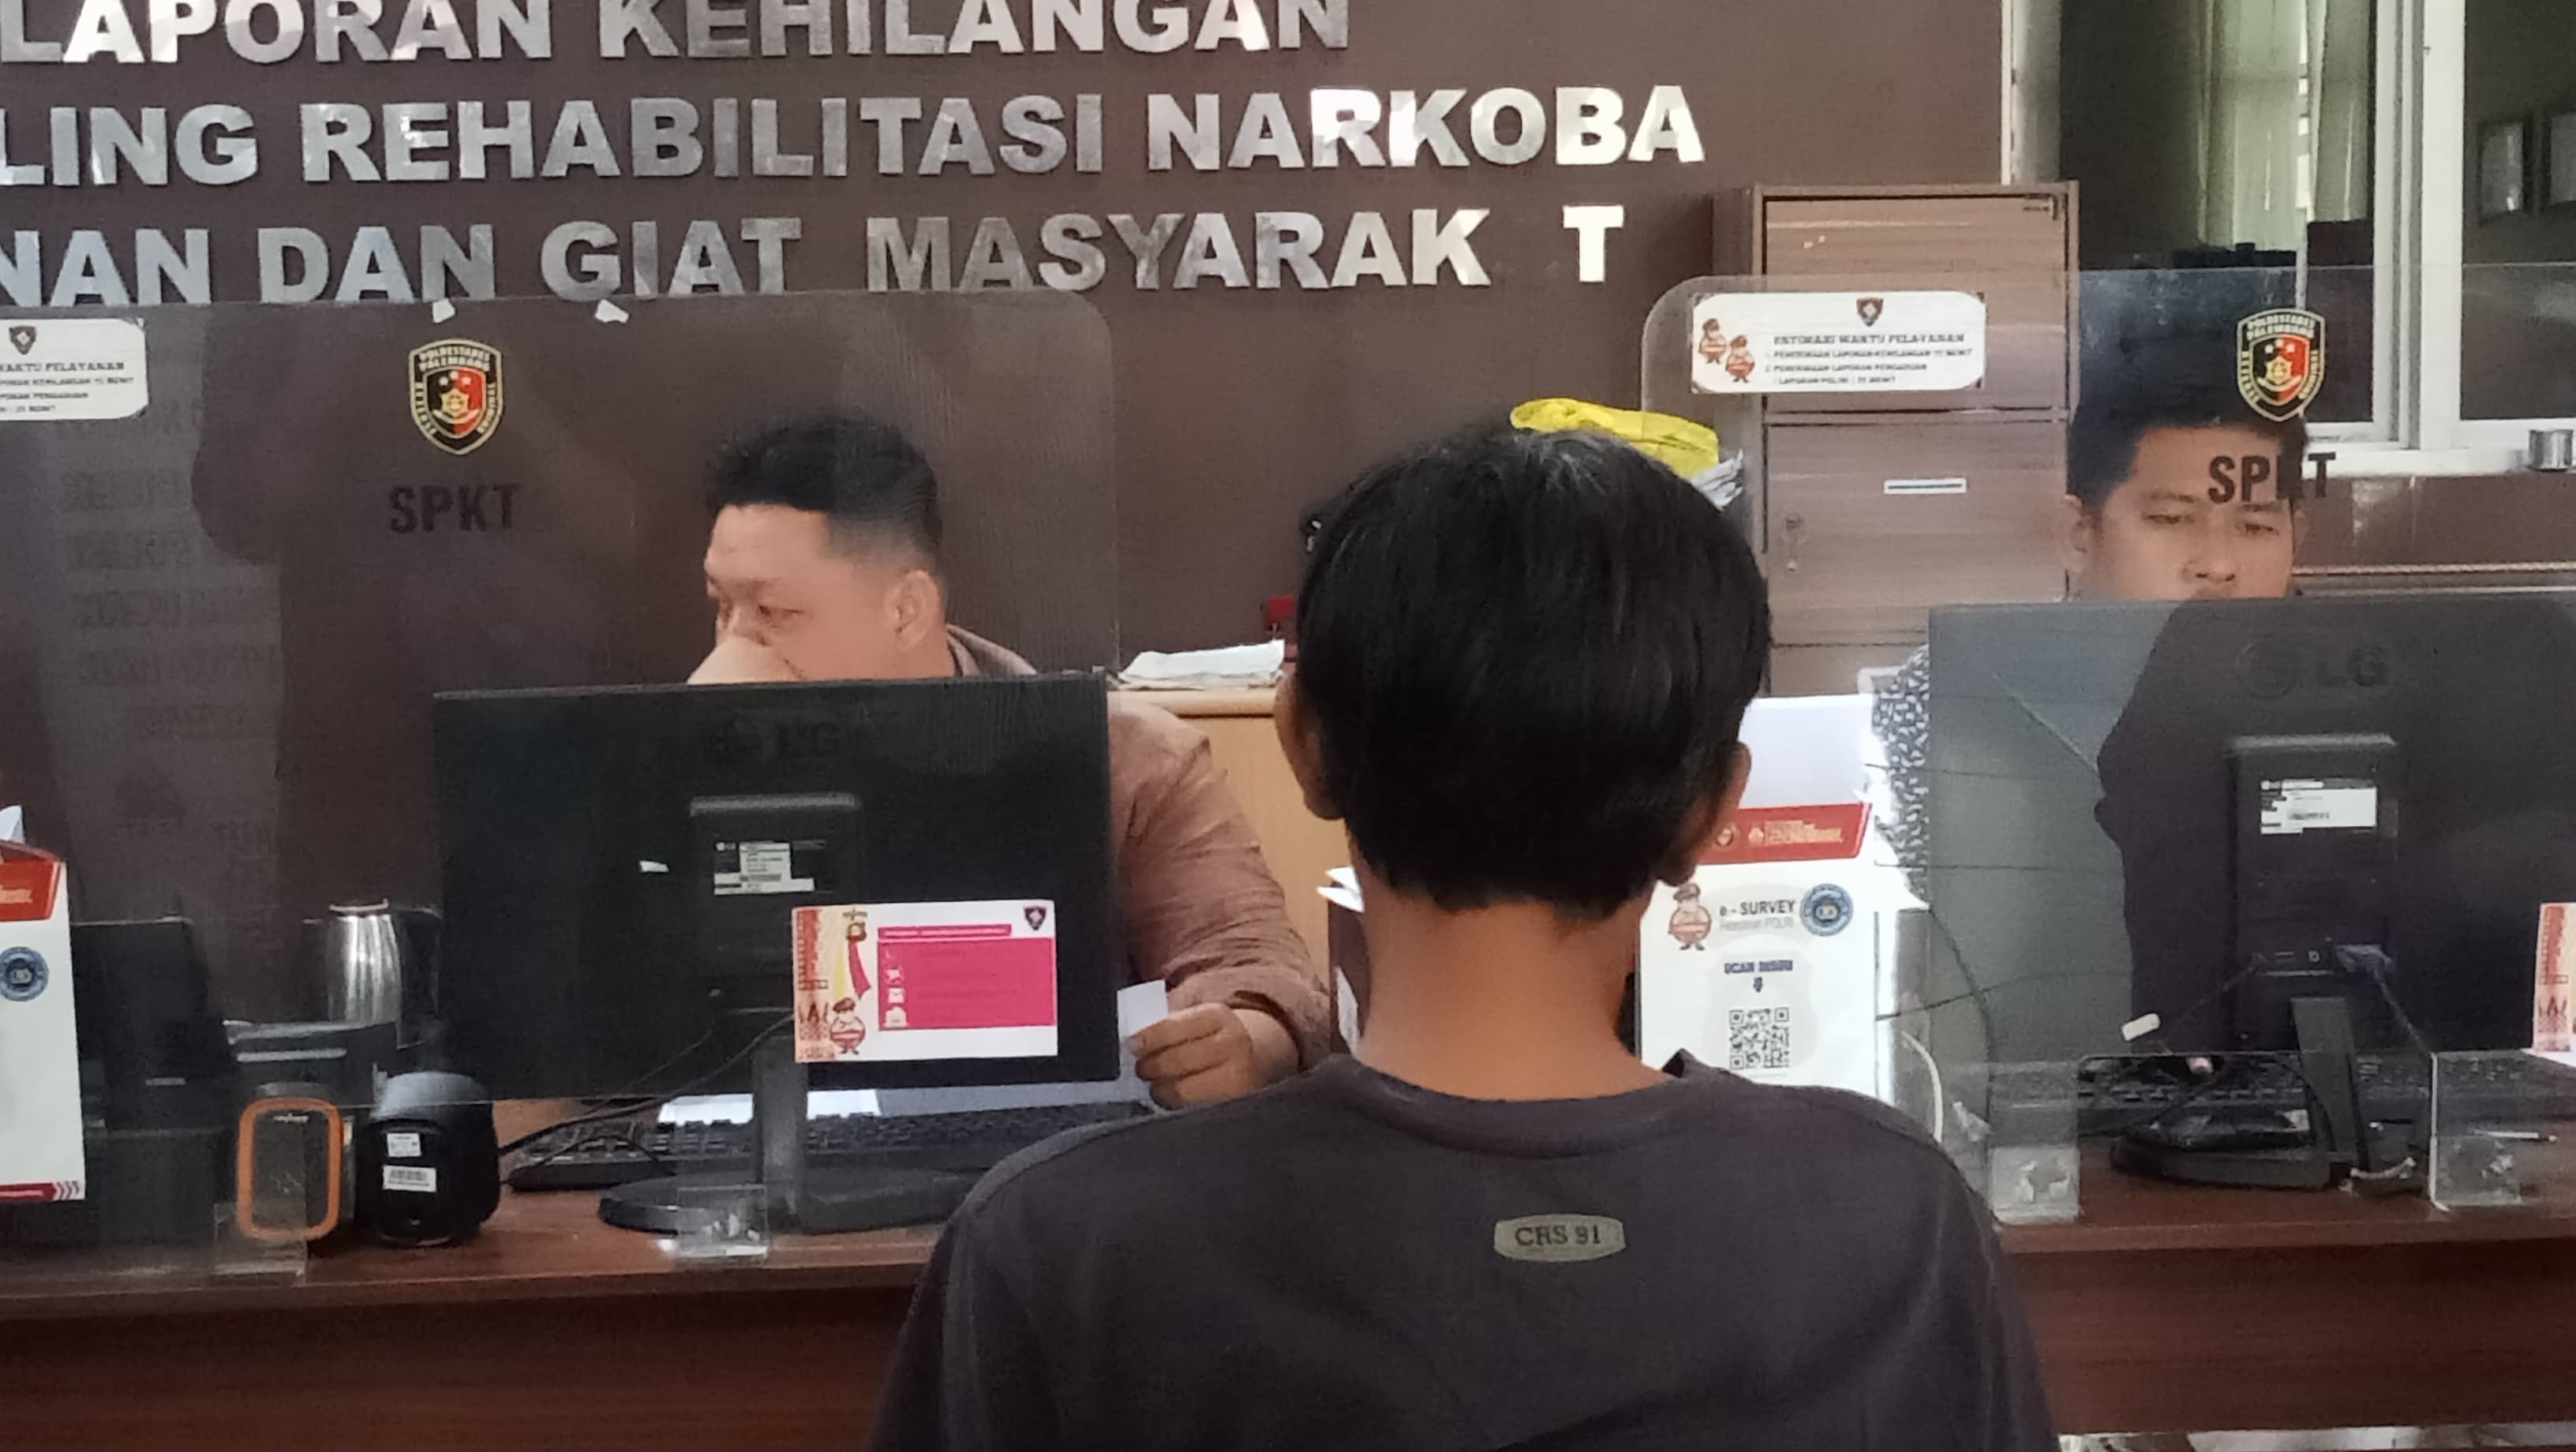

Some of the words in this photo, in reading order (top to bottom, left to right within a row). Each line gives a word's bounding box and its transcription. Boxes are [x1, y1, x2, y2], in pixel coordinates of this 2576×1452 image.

[0, 0, 551, 63] LAPORAN
[599, 0, 1349, 59] KEHILANGAN
[299, 93, 1103, 183] REHABILITASI
[1147, 84, 1705, 171] NARKOBA
[258, 224, 496, 305] DAN
[541, 217, 802, 301] GIAT
[867, 208, 1491, 292] MASYARAK
[1563, 204, 1625, 283] T
[391, 482, 521, 533] SPKT
[1739, 900, 1795, 915] SURVEY
[1574, 1224, 1601, 1245] 91
